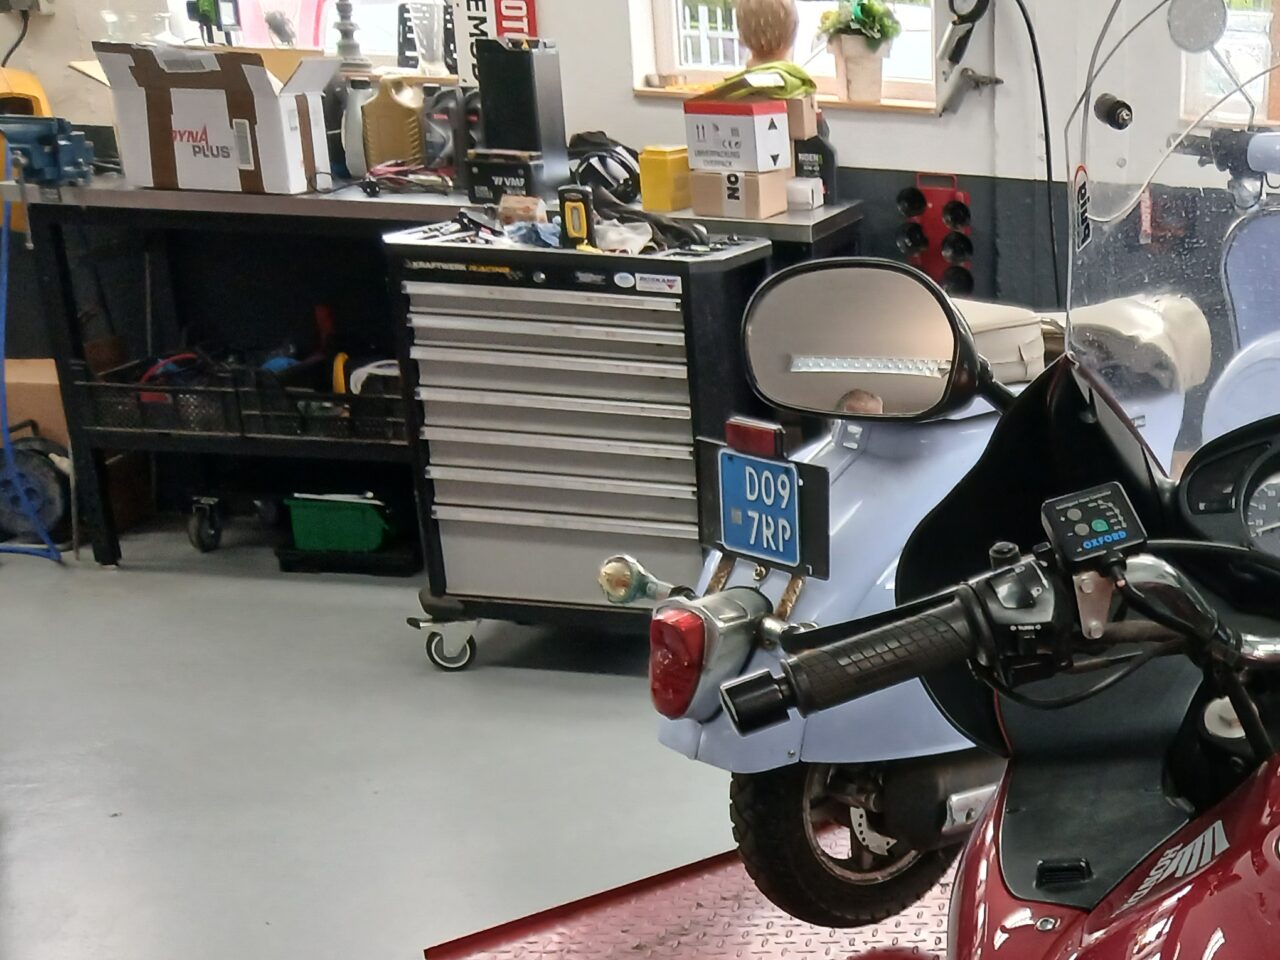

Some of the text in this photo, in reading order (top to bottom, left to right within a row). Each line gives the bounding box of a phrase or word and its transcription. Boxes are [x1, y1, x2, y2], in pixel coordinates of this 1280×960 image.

[191, 145, 231, 158] PLUS
[747, 510, 791, 552] 7RP
[1082, 530, 1127, 549] OXFORD
